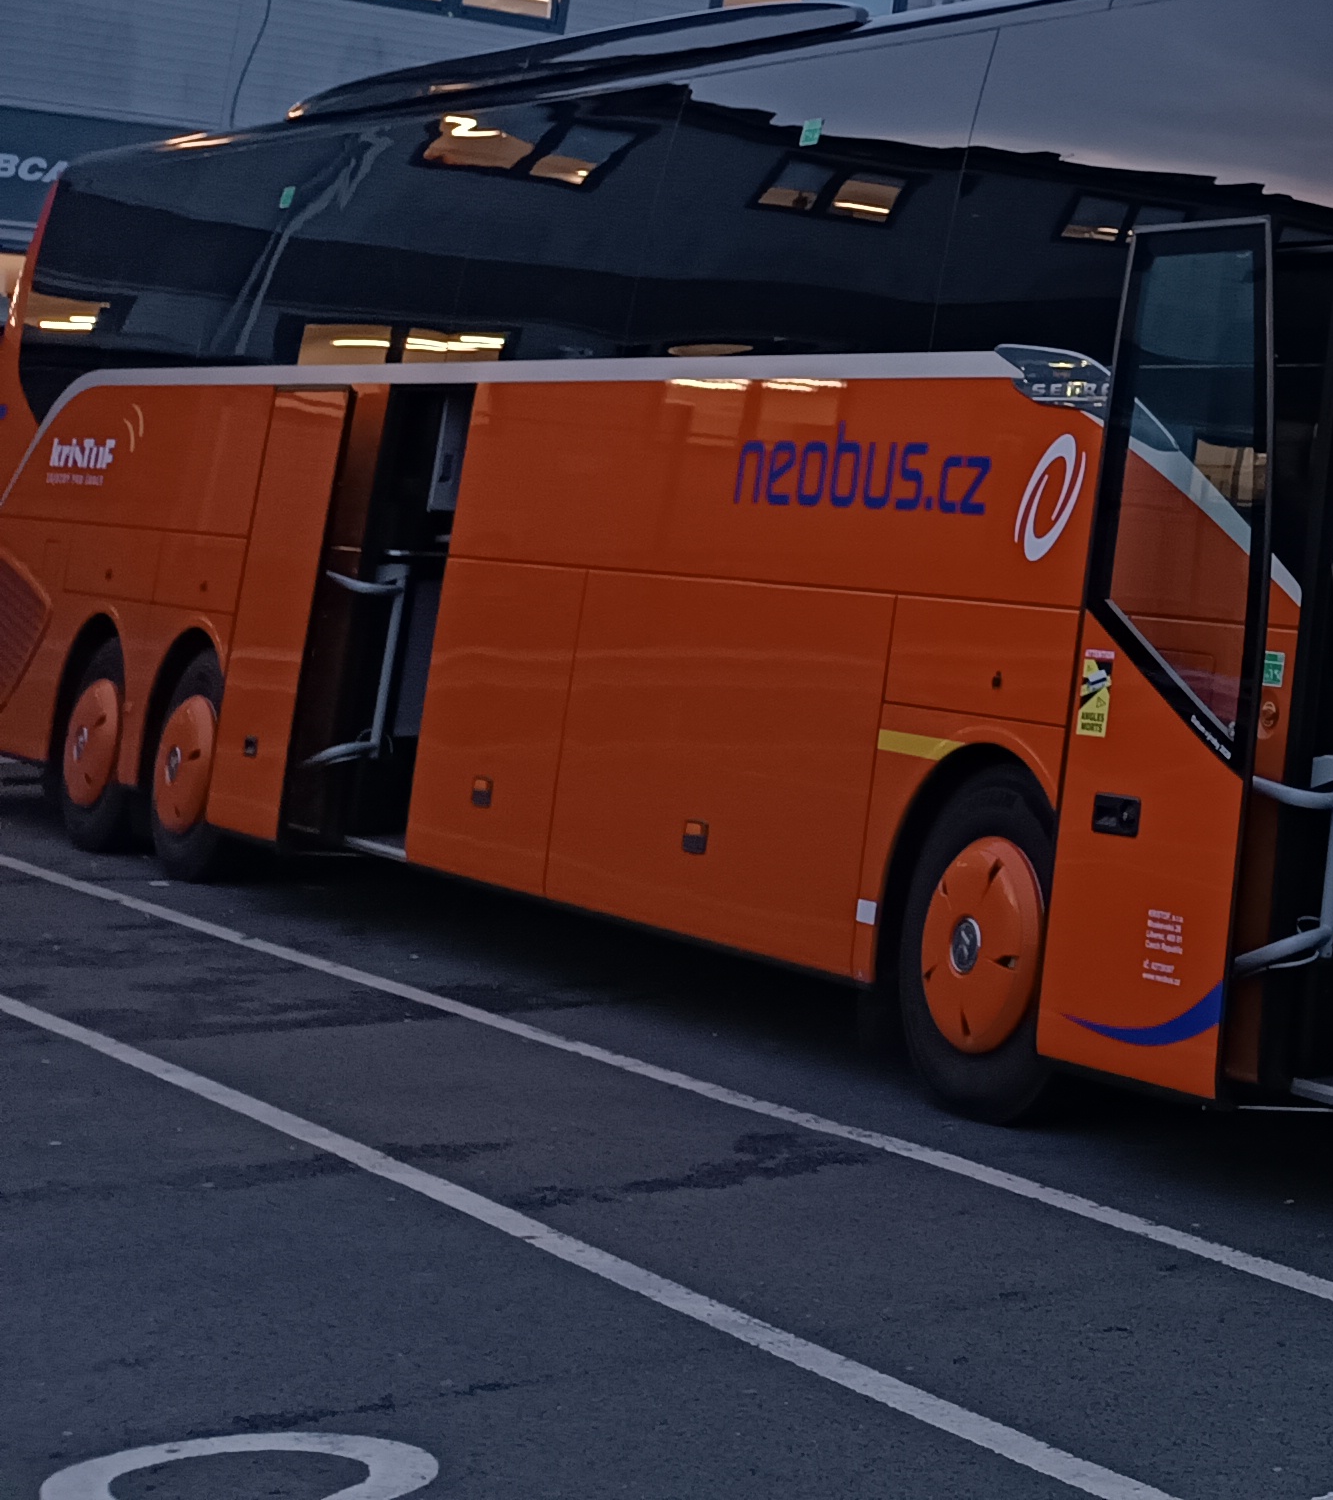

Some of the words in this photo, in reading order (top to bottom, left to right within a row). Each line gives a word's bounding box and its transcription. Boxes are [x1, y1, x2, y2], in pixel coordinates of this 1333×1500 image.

[733, 419, 992, 516] neobus.cz
[1081, 711, 1105, 723] ANGLES
[1080, 722, 1103, 733] MORTS
